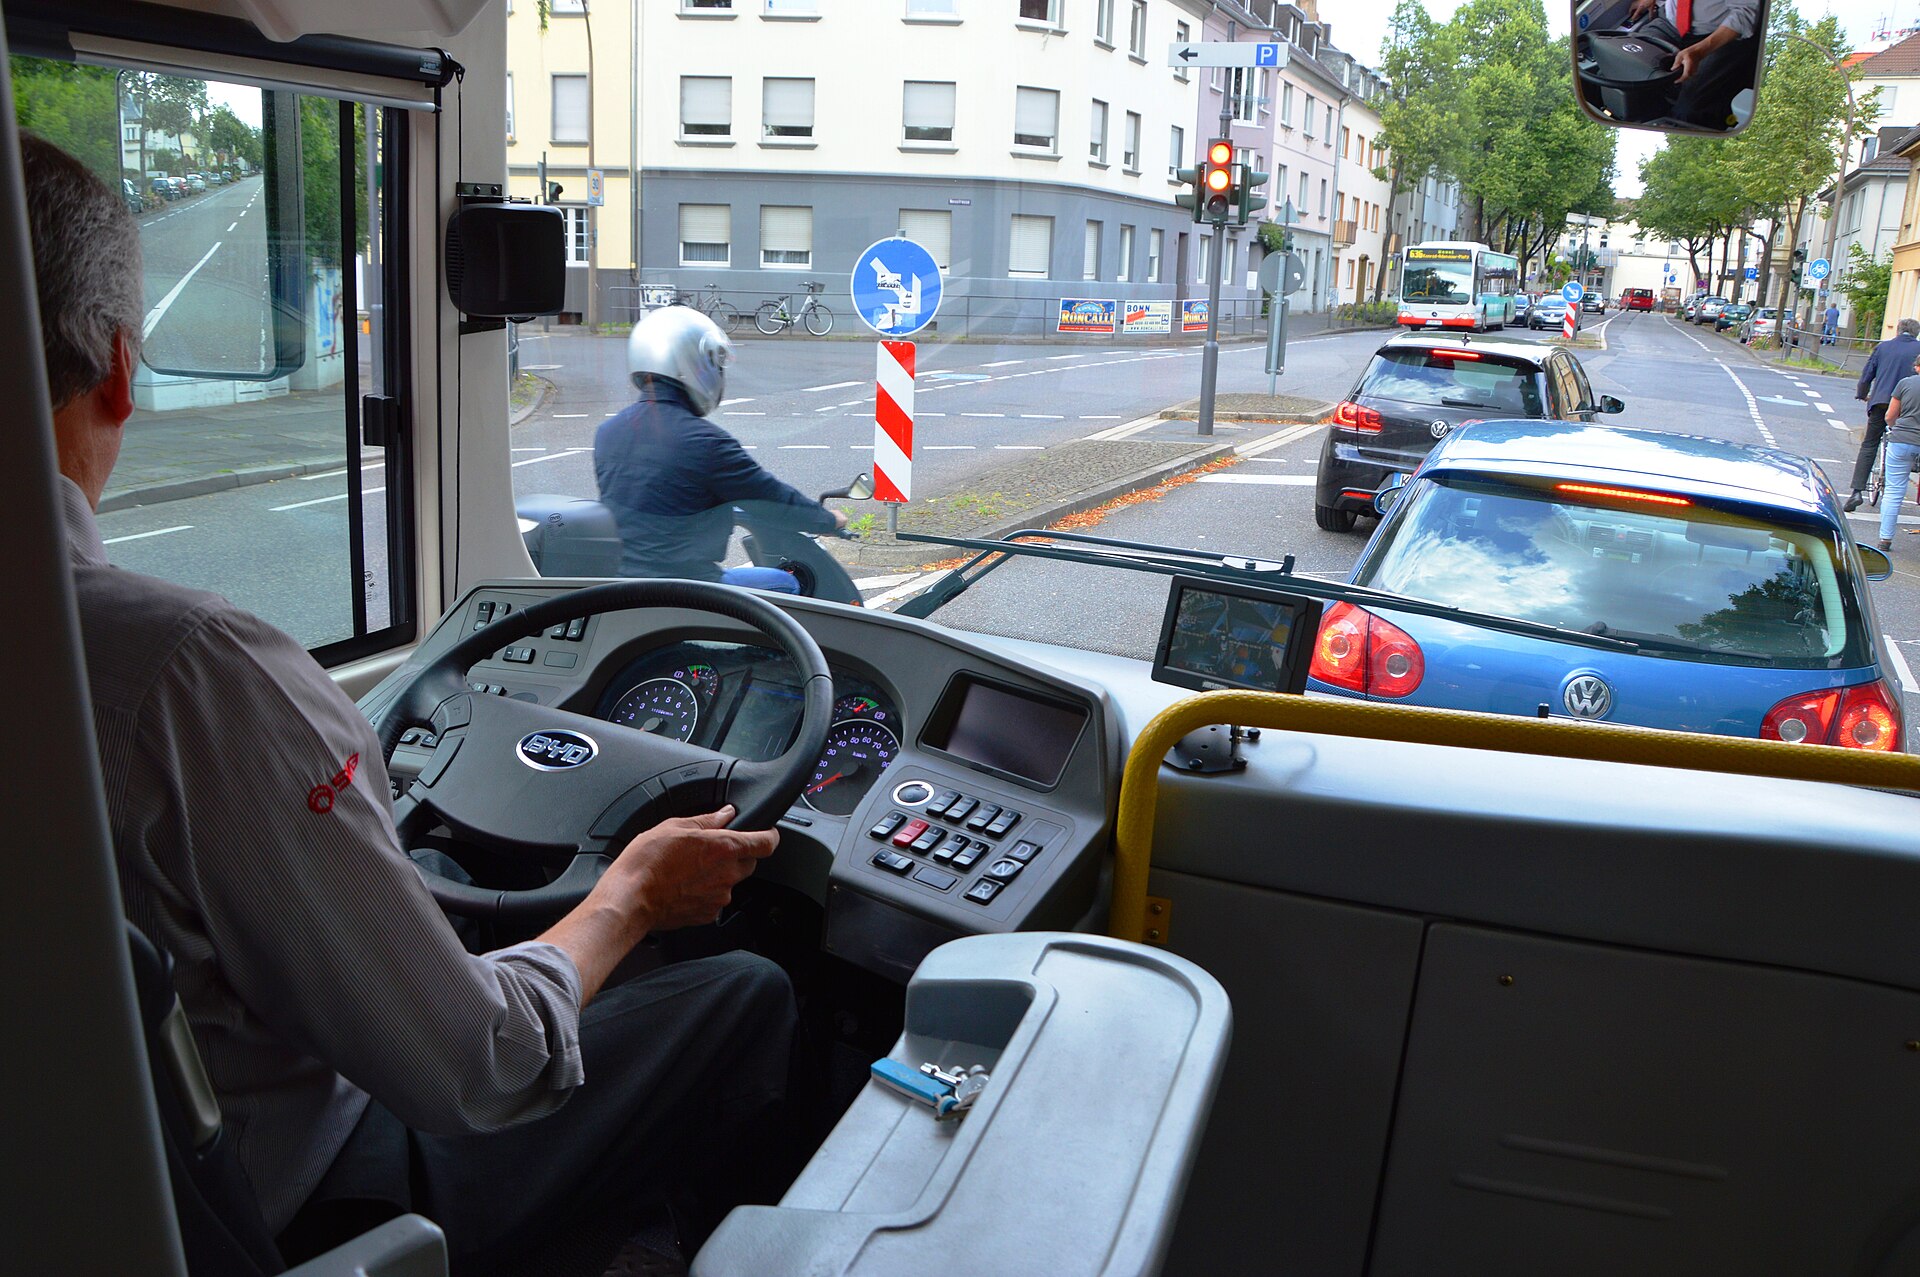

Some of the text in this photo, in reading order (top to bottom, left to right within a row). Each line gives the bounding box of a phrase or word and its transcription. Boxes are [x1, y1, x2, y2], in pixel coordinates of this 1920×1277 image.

[1261, 46, 1273, 64] P
[592, 177, 599, 190] 30
[1410, 250, 1424, 258] 636
[1061, 310, 1114, 324] RONCALLI
[1401, 475, 1410, 486] K
[681, 724, 688, 732] 8
[522, 734, 590, 764] BYD
[872, 741, 881, 749] 70
[878, 750, 888, 758] 80
[1015, 844, 1031, 856] D
[995, 862, 1012, 874] N
[974, 883, 992, 897] R
